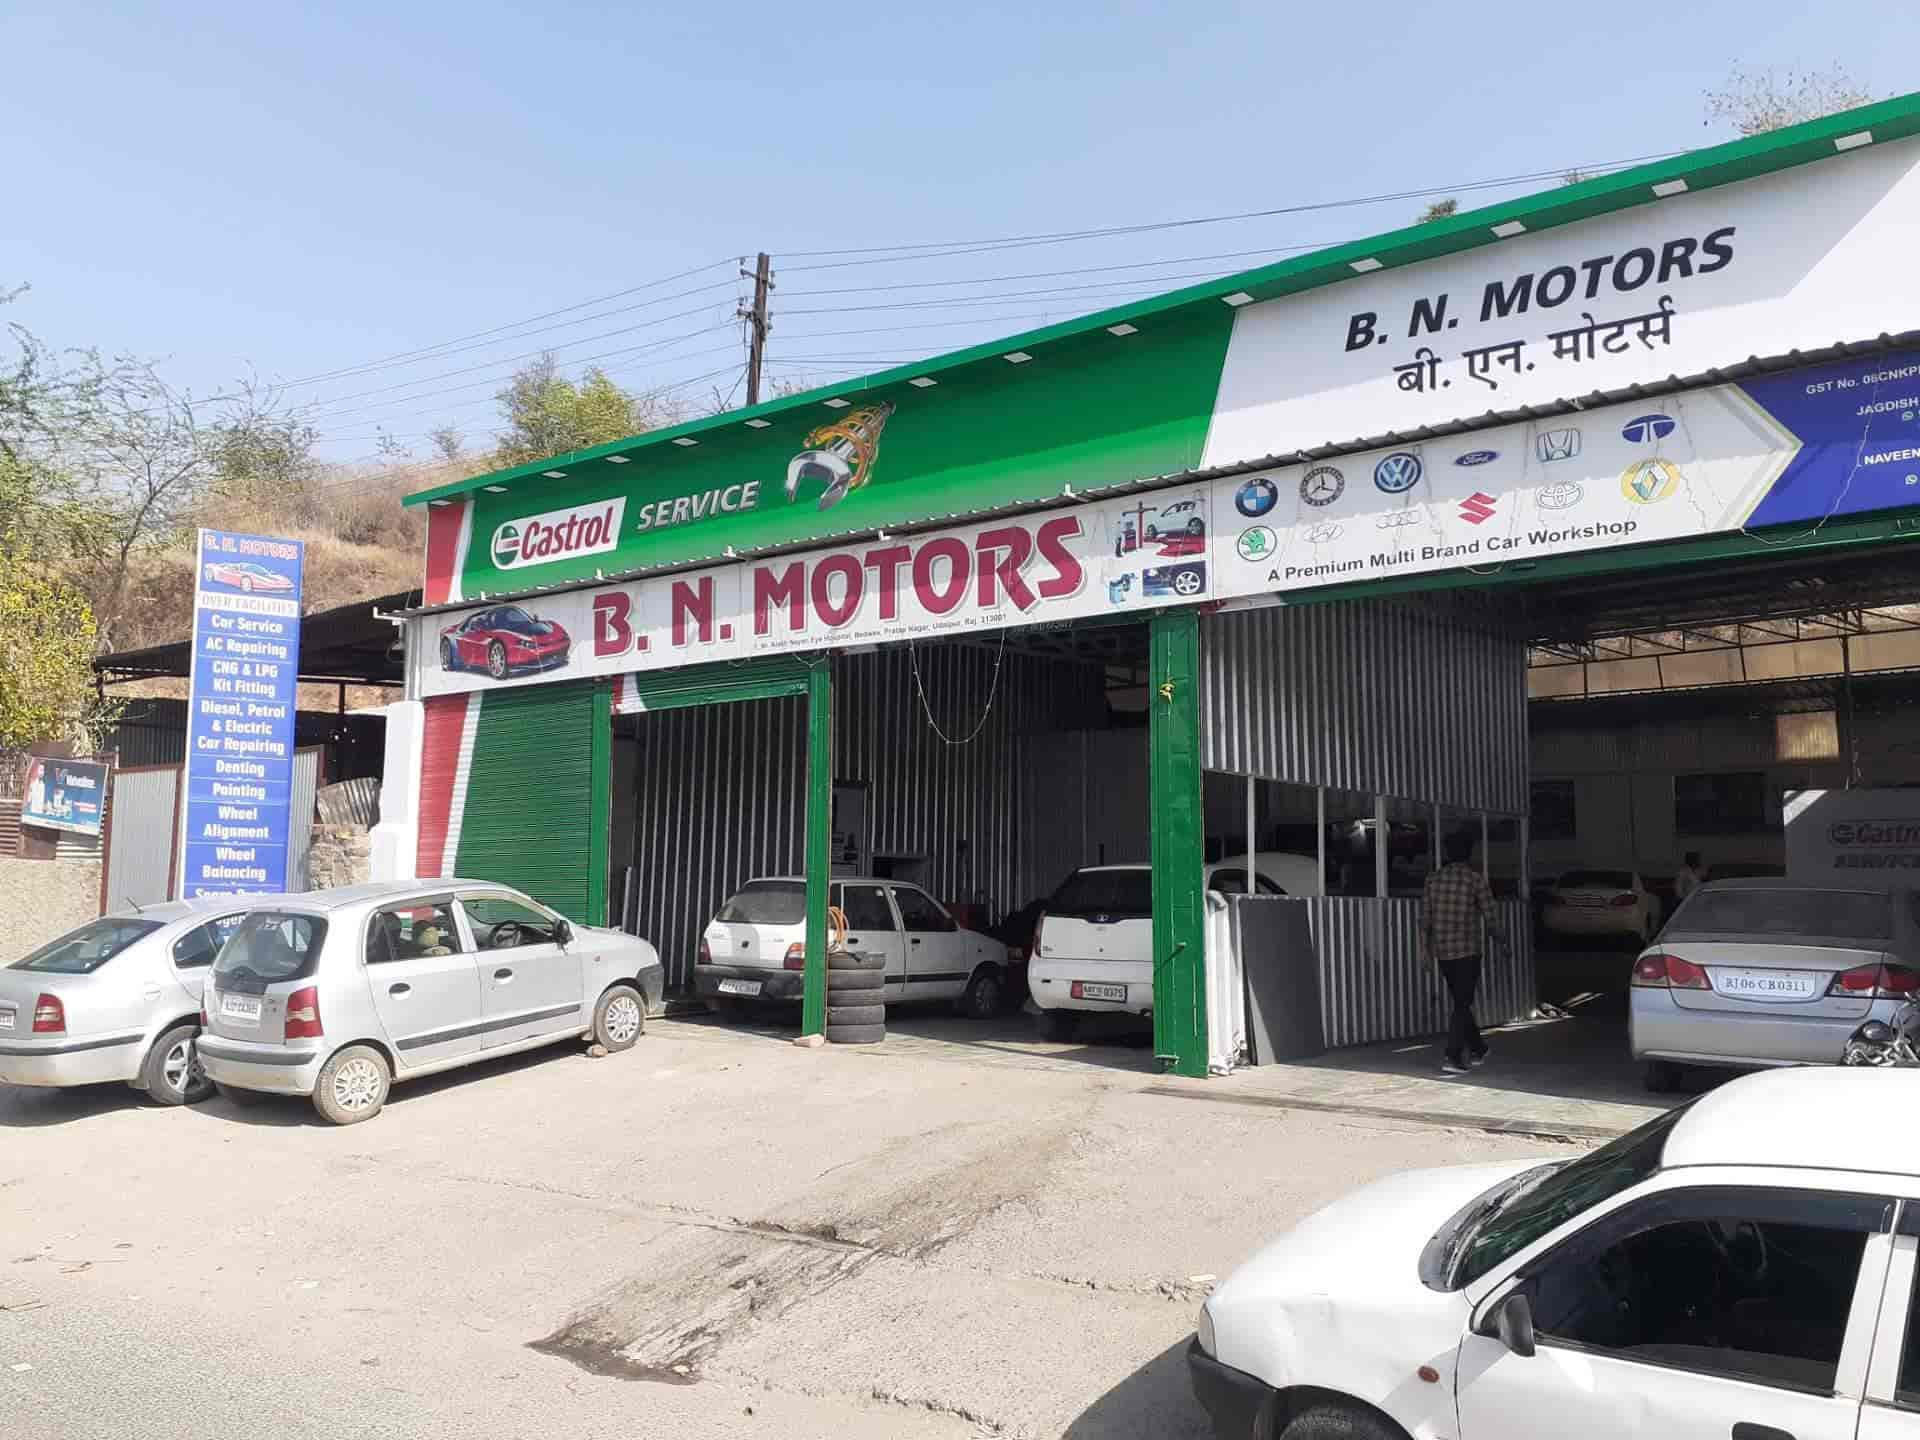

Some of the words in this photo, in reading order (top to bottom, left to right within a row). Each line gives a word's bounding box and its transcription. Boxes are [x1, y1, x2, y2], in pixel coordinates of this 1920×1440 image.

[1345, 311, 1388, 352] B.
[1408, 294, 1458, 337] N.
[1480, 227, 1736, 322] MOTORS
[1393, 347, 1451, 392] बी.
[1463, 340, 1535, 390] एन.
[1547, 295, 1676, 361] मोटर्स
[1806, 381, 1833, 394] GST
[1837, 378, 1859, 390] No.
[1863, 365, 1920, 385] 08CNKP
[1856, 397, 1918, 416] JAGDISH
[1864, 449, 1920, 465] NAVEEN
[637, 480, 760, 530] SERVICE
[520, 506, 614, 560] Castrol
[1267, 568, 1282, 582] A
[1285, 557, 1363, 580] Premium
[1370, 548, 1415, 568] Multi
[1422, 540, 1480, 561] Brand
[1487, 535, 1522, 551] Car
[1528, 518, 1637, 546] Workshop
[593, 591, 649, 657] B.
[672, 576, 733, 647] N.
[754, 515, 1083, 635] MOTORS
[211, 615, 233, 629] Car
[237, 617, 283, 633] Service
[206, 637, 223, 650] AC
[227, 639, 287, 658] Repairing
[213, 660, 238, 676] CNG
[242, 663, 251, 675] &
[255, 664, 278, 678] LPG
[213, 679, 233, 692] Kit
[236, 680, 275, 698] Fitting
[247, 703, 285, 718] Petrol
[211, 720, 222, 732] &
[225, 721, 273, 735] Electric
[198, 736, 220, 749] Car
[224, 737, 284, 756] Repairing
[216, 760, 265, 778] Denting
[212, 782, 265, 800] Painting
[218, 806, 257, 820] Wheel
[204, 824, 269, 840] Alignment
[216, 848, 256, 861] Wheel
[202, 865, 266, 881] Balancing
